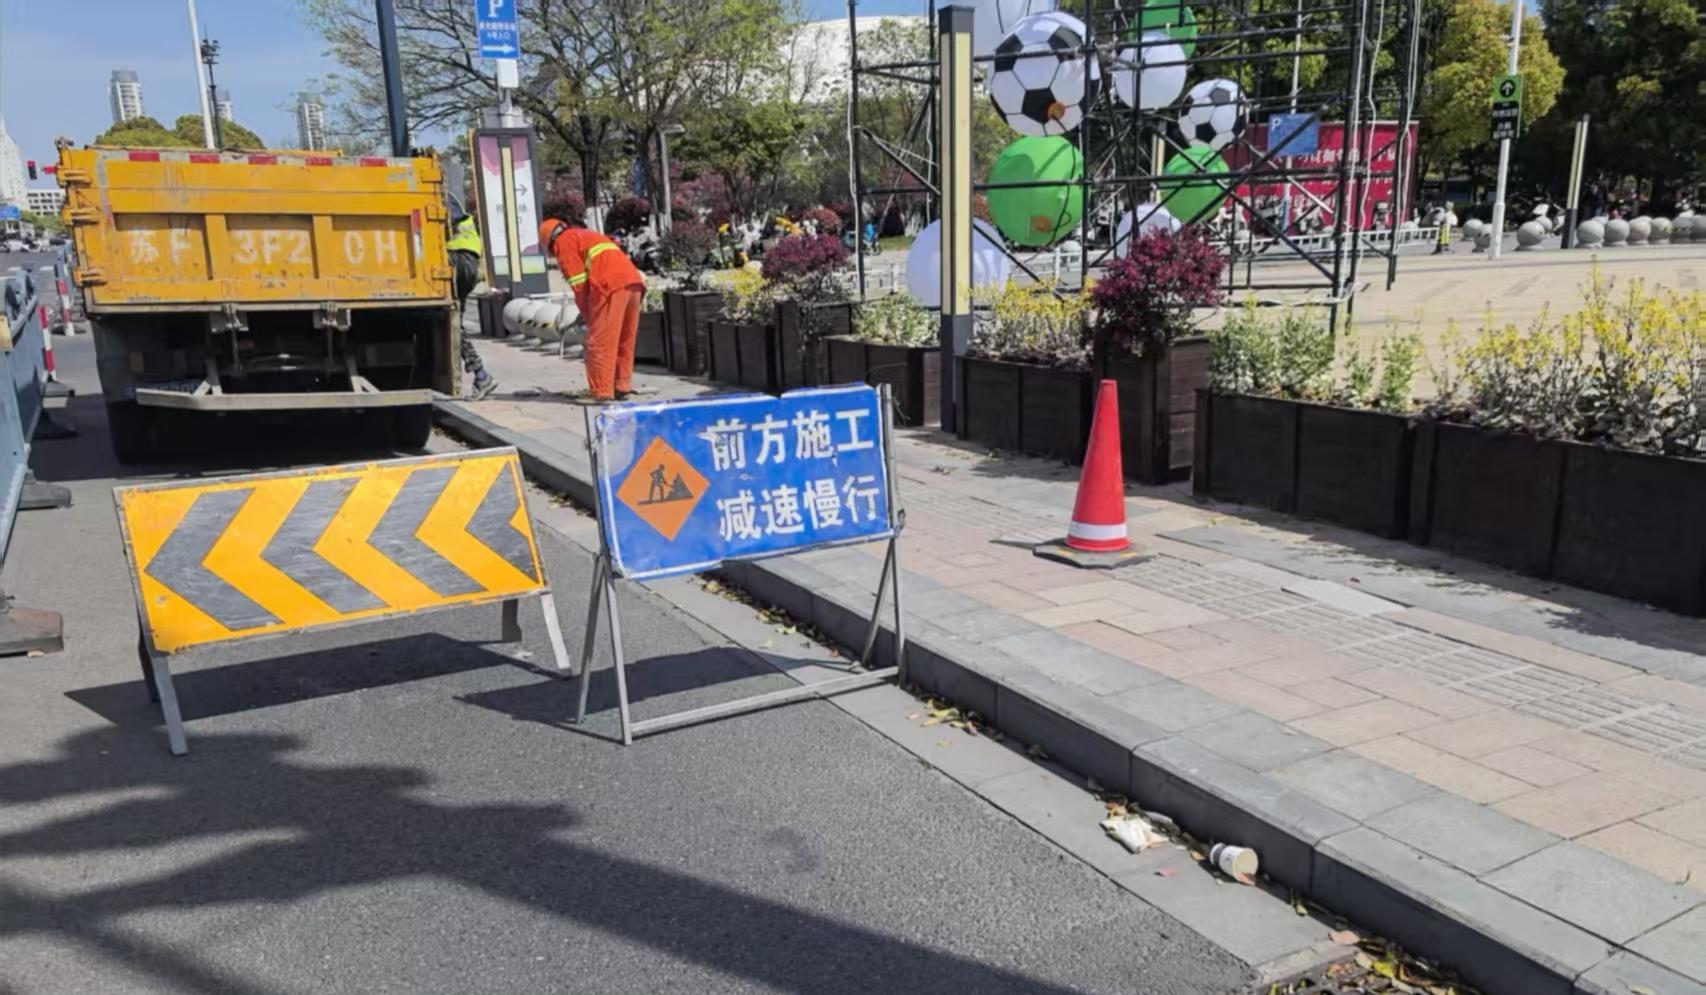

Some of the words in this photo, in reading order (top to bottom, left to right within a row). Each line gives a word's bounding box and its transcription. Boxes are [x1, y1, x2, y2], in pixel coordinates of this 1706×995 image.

[487, 0, 504, 17] P
[1271, 117, 1282, 131] P
[704, 408, 875, 472] 前方施工
[716, 474, 881, 542] 减速慢行
